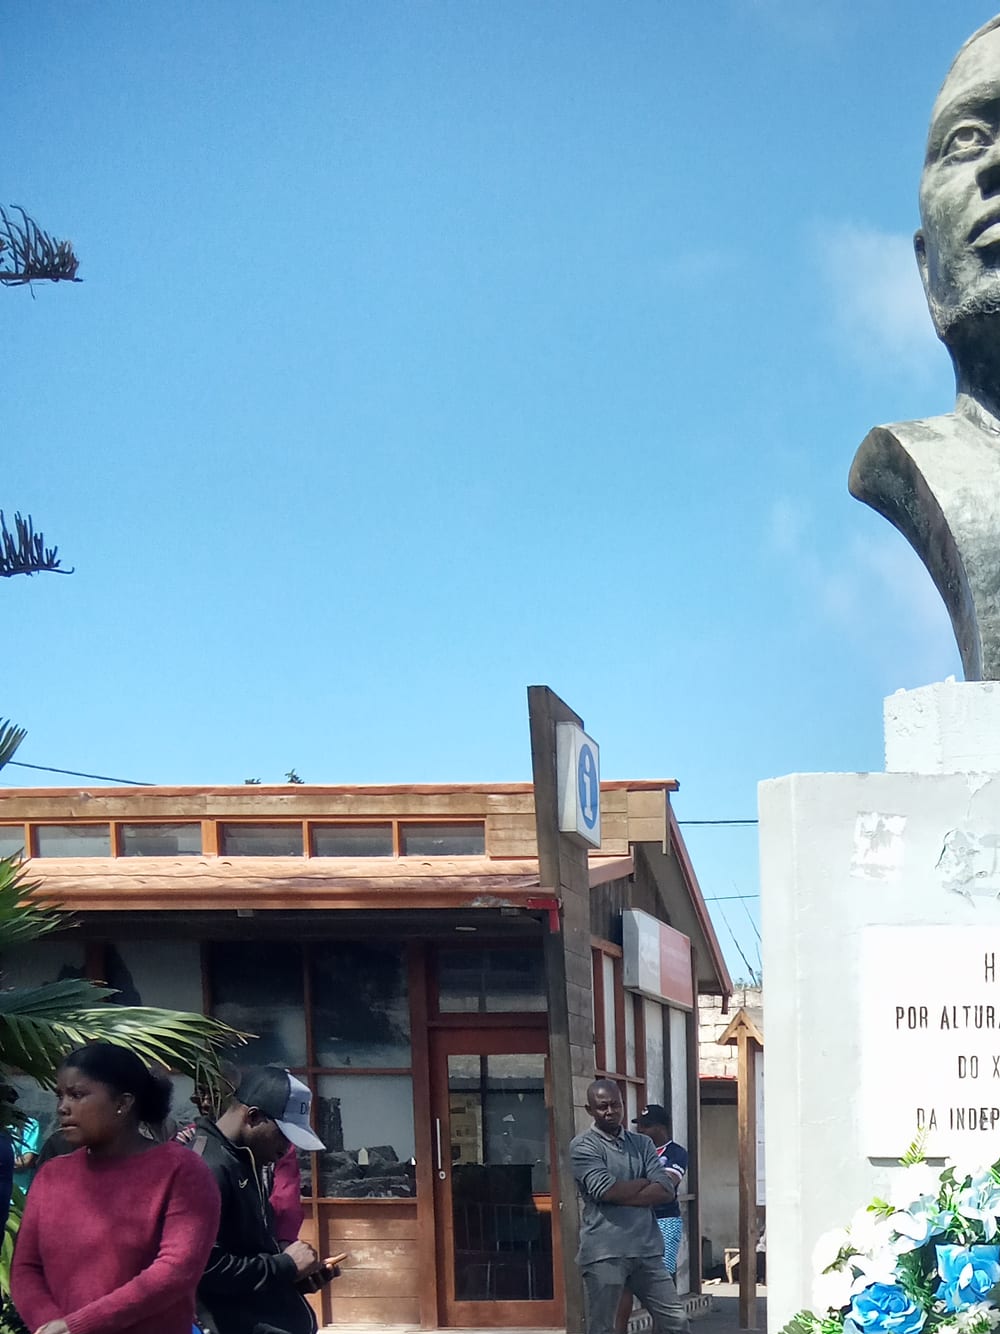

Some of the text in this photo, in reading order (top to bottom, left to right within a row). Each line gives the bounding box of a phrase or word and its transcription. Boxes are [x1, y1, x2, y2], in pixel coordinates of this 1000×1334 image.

[895, 1006, 928, 1030] POR
[958, 1055, 979, 1079] DO
[916, 1107, 938, 1131] DA
